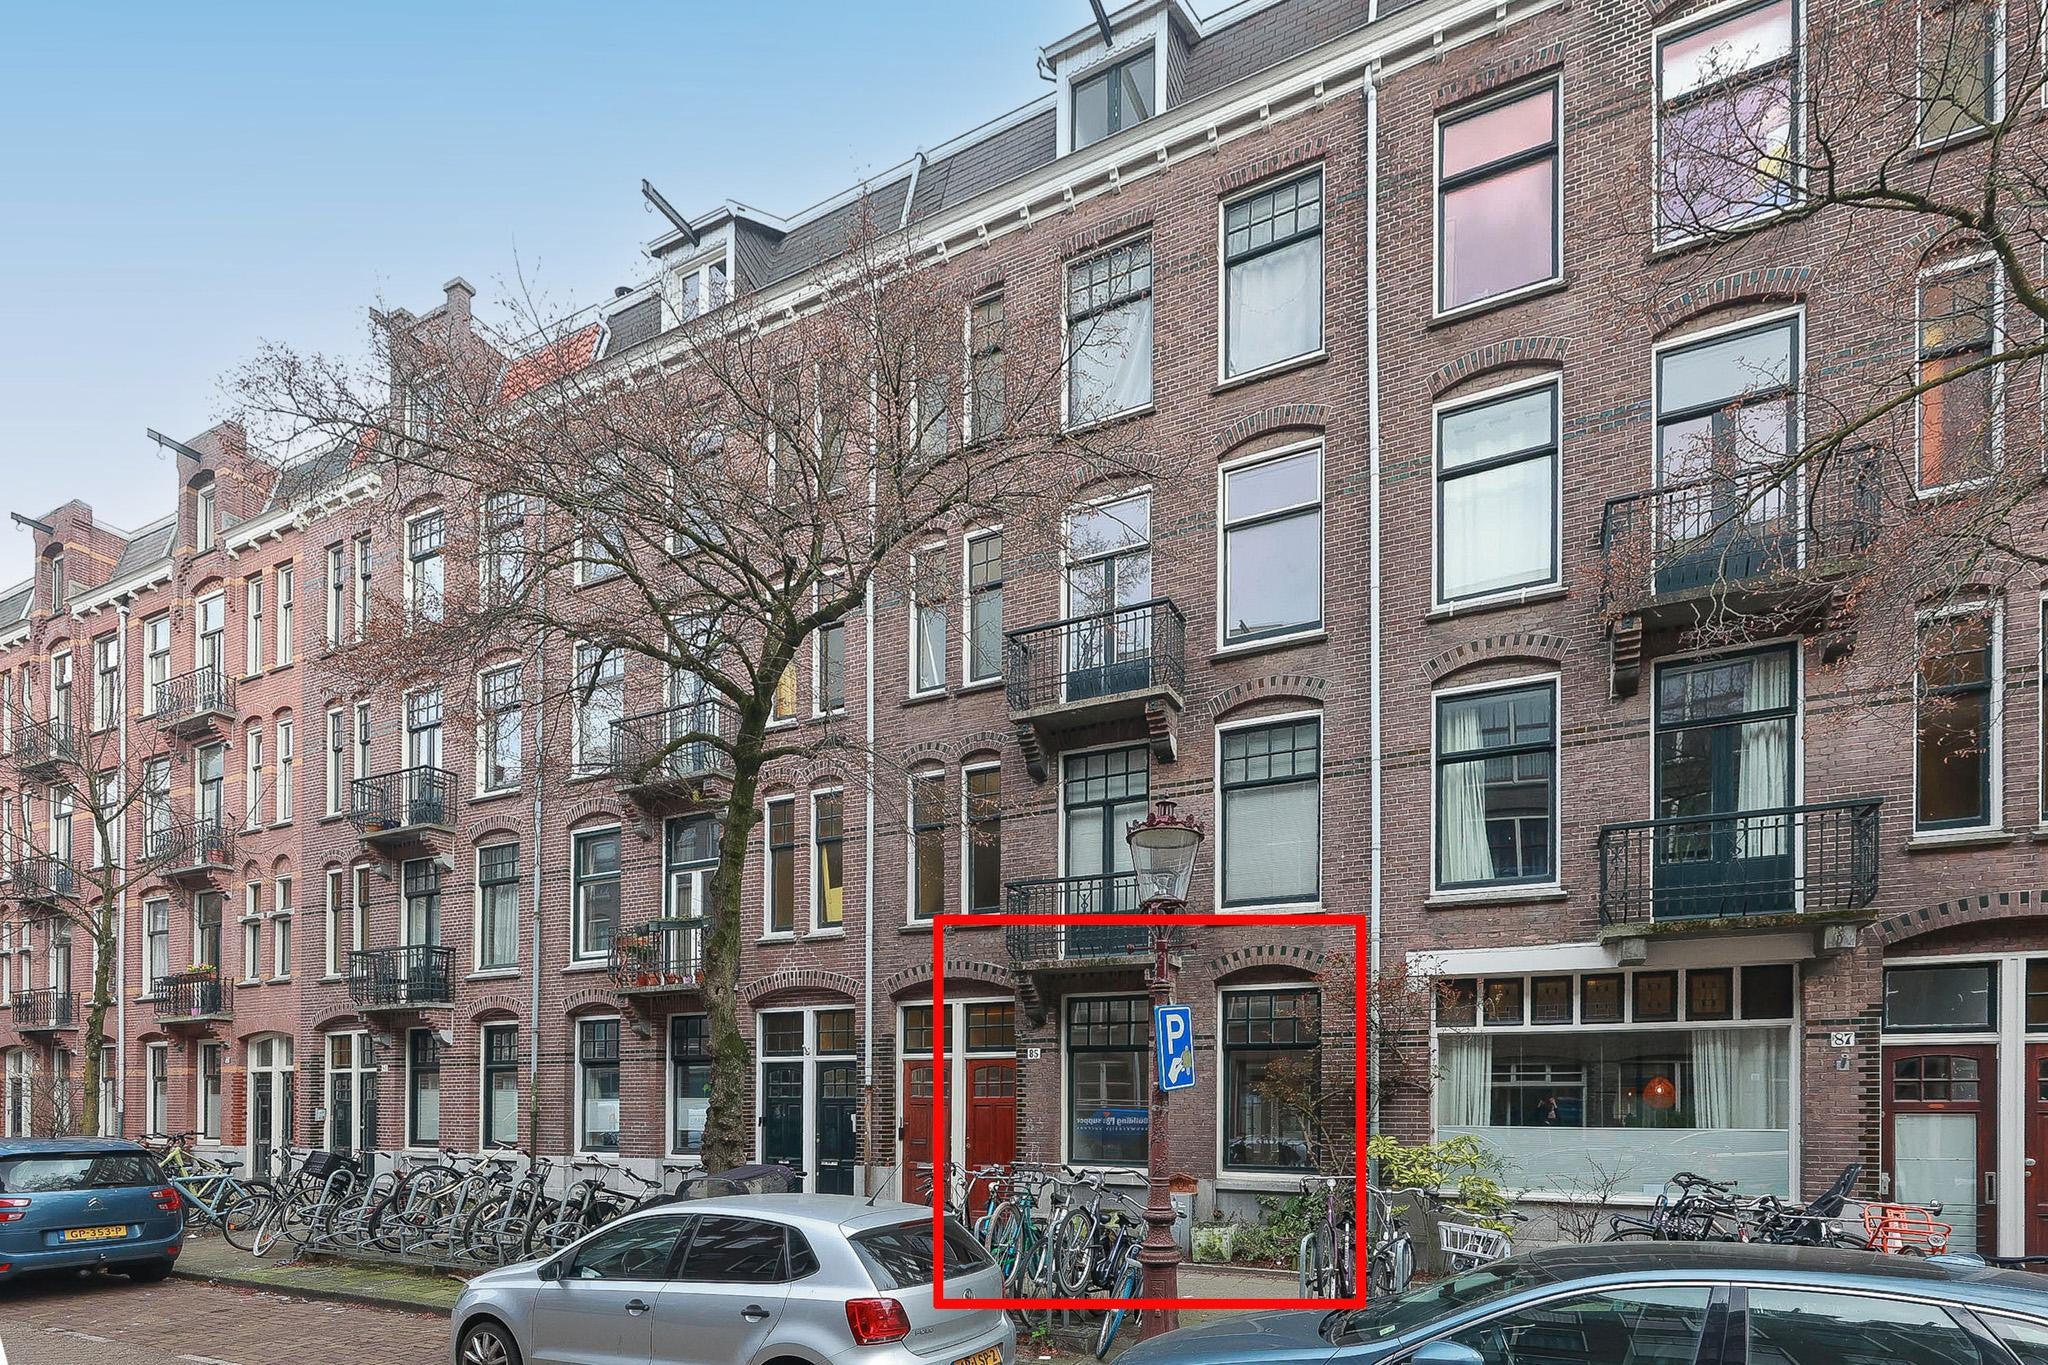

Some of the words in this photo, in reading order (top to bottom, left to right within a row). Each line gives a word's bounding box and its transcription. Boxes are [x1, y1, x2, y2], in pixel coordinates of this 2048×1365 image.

[1166, 1014, 1184, 1054] P
[1834, 1033, 1854, 1046] 87
[1028, 1049, 1039, 1059] 85
[70, 1227, 122, 1239] GP-353-P
